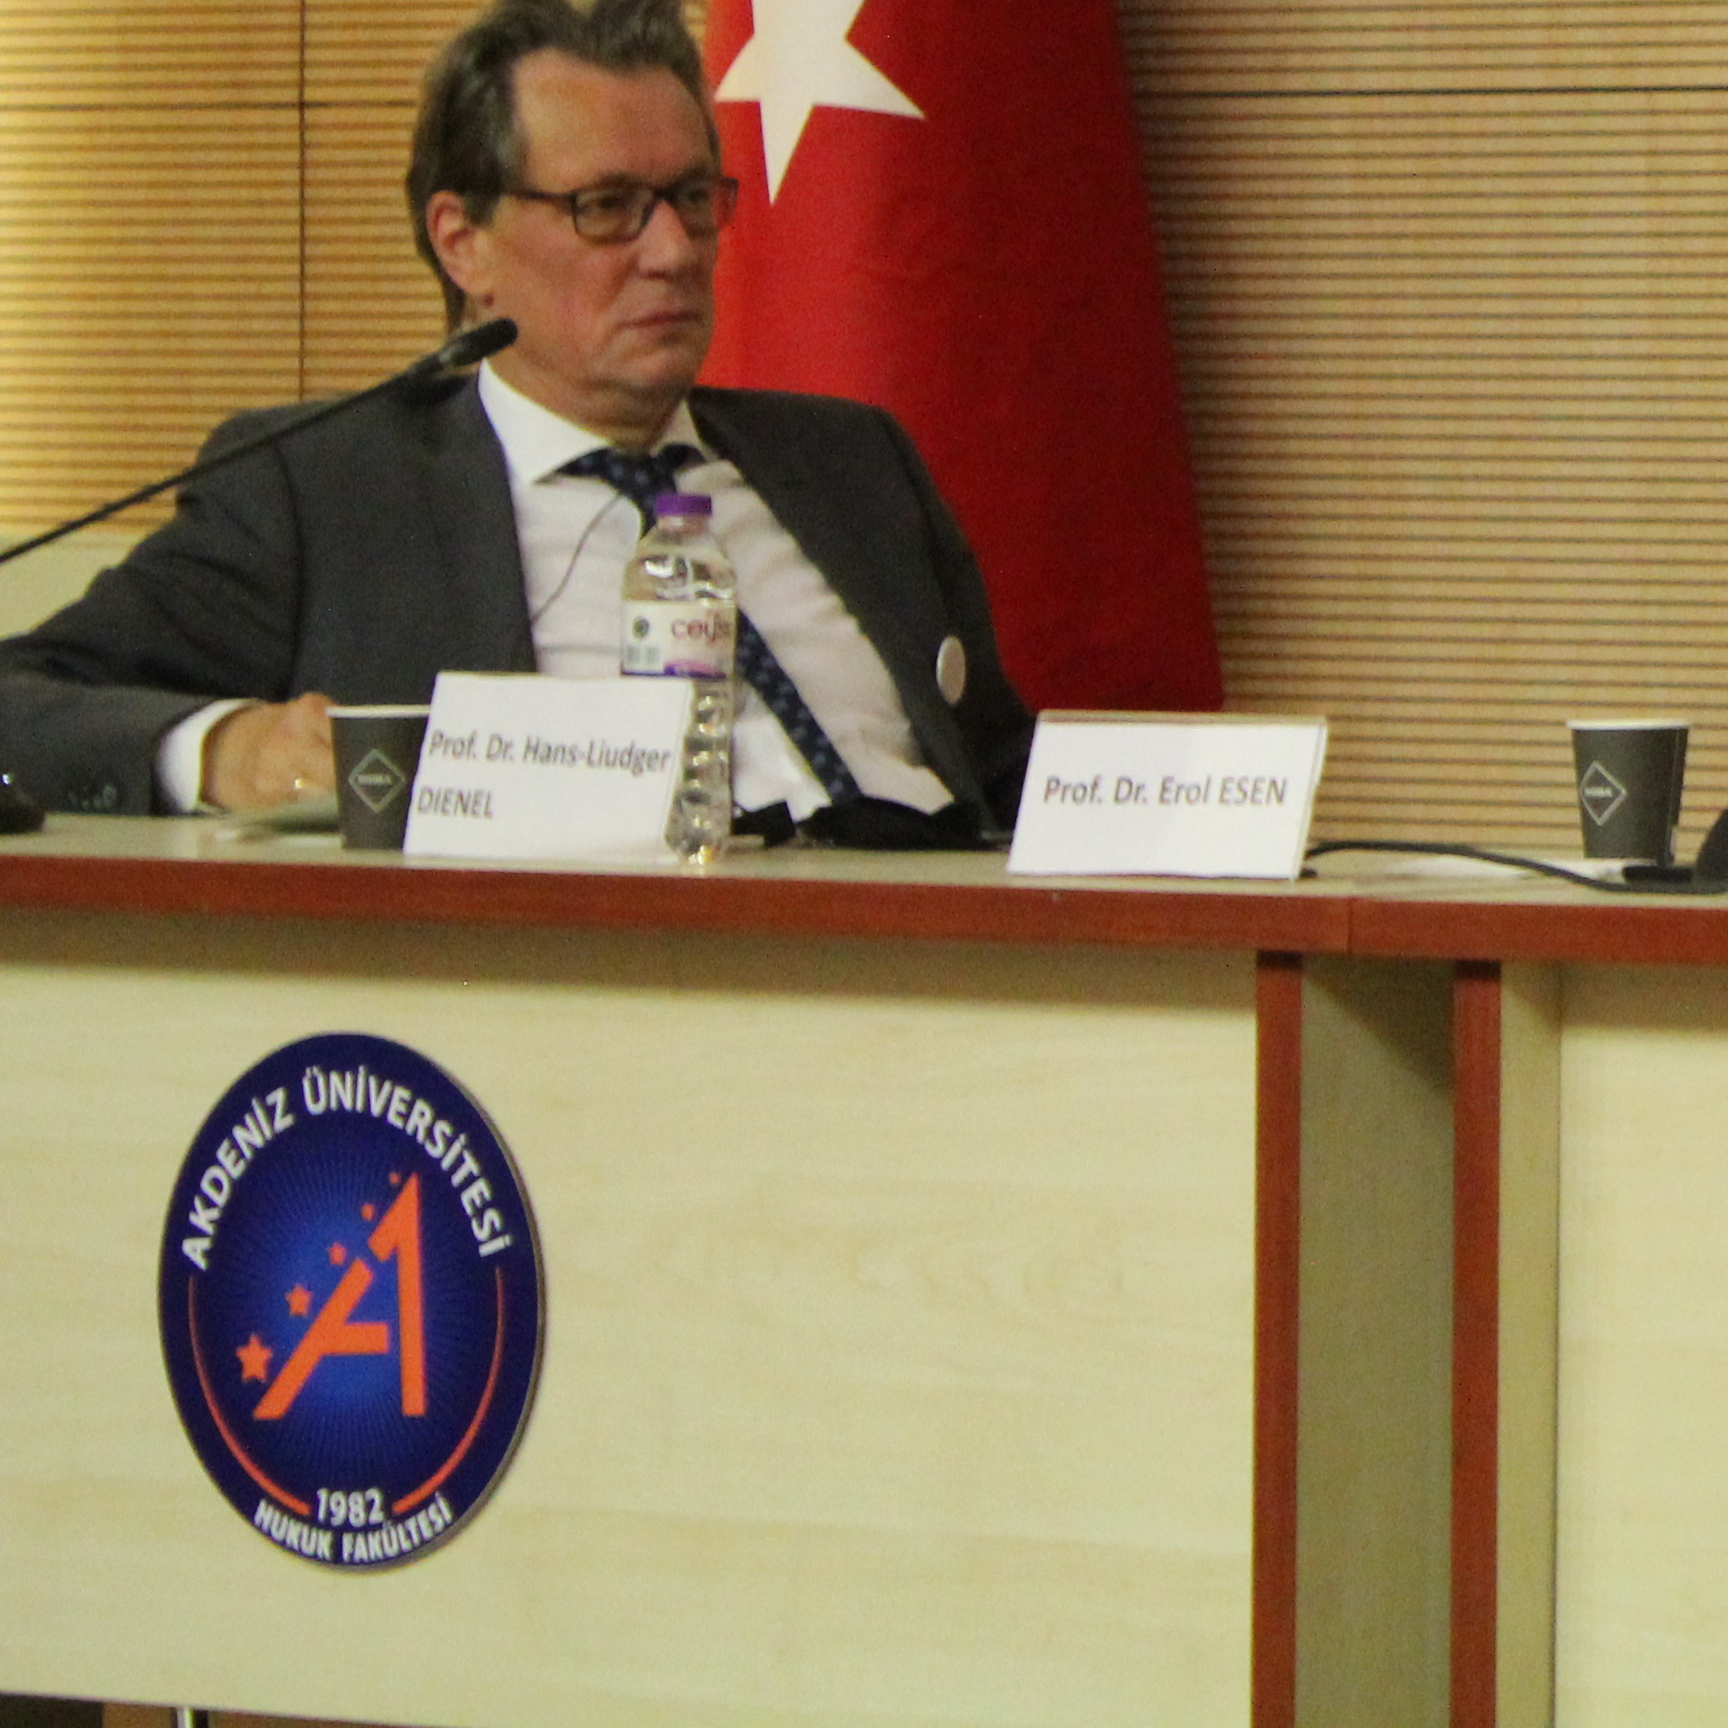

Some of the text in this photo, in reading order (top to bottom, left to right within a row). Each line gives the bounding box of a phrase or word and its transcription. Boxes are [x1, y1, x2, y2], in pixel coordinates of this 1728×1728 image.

[429, 729, 671, 776] Prof. Dr. Hans-Liudger
[417, 785, 494, 819] DIENEL
[1043, 774, 1288, 806] Prof. Dr. Erol ESEN
[182, 1064, 512, 1270] AKDENİZ ÜNİVERSİTESİ
[254, 1491, 453, 1562] HUKUK FAKÜLTESİ
[317, 1487, 385, 1527] 1982
